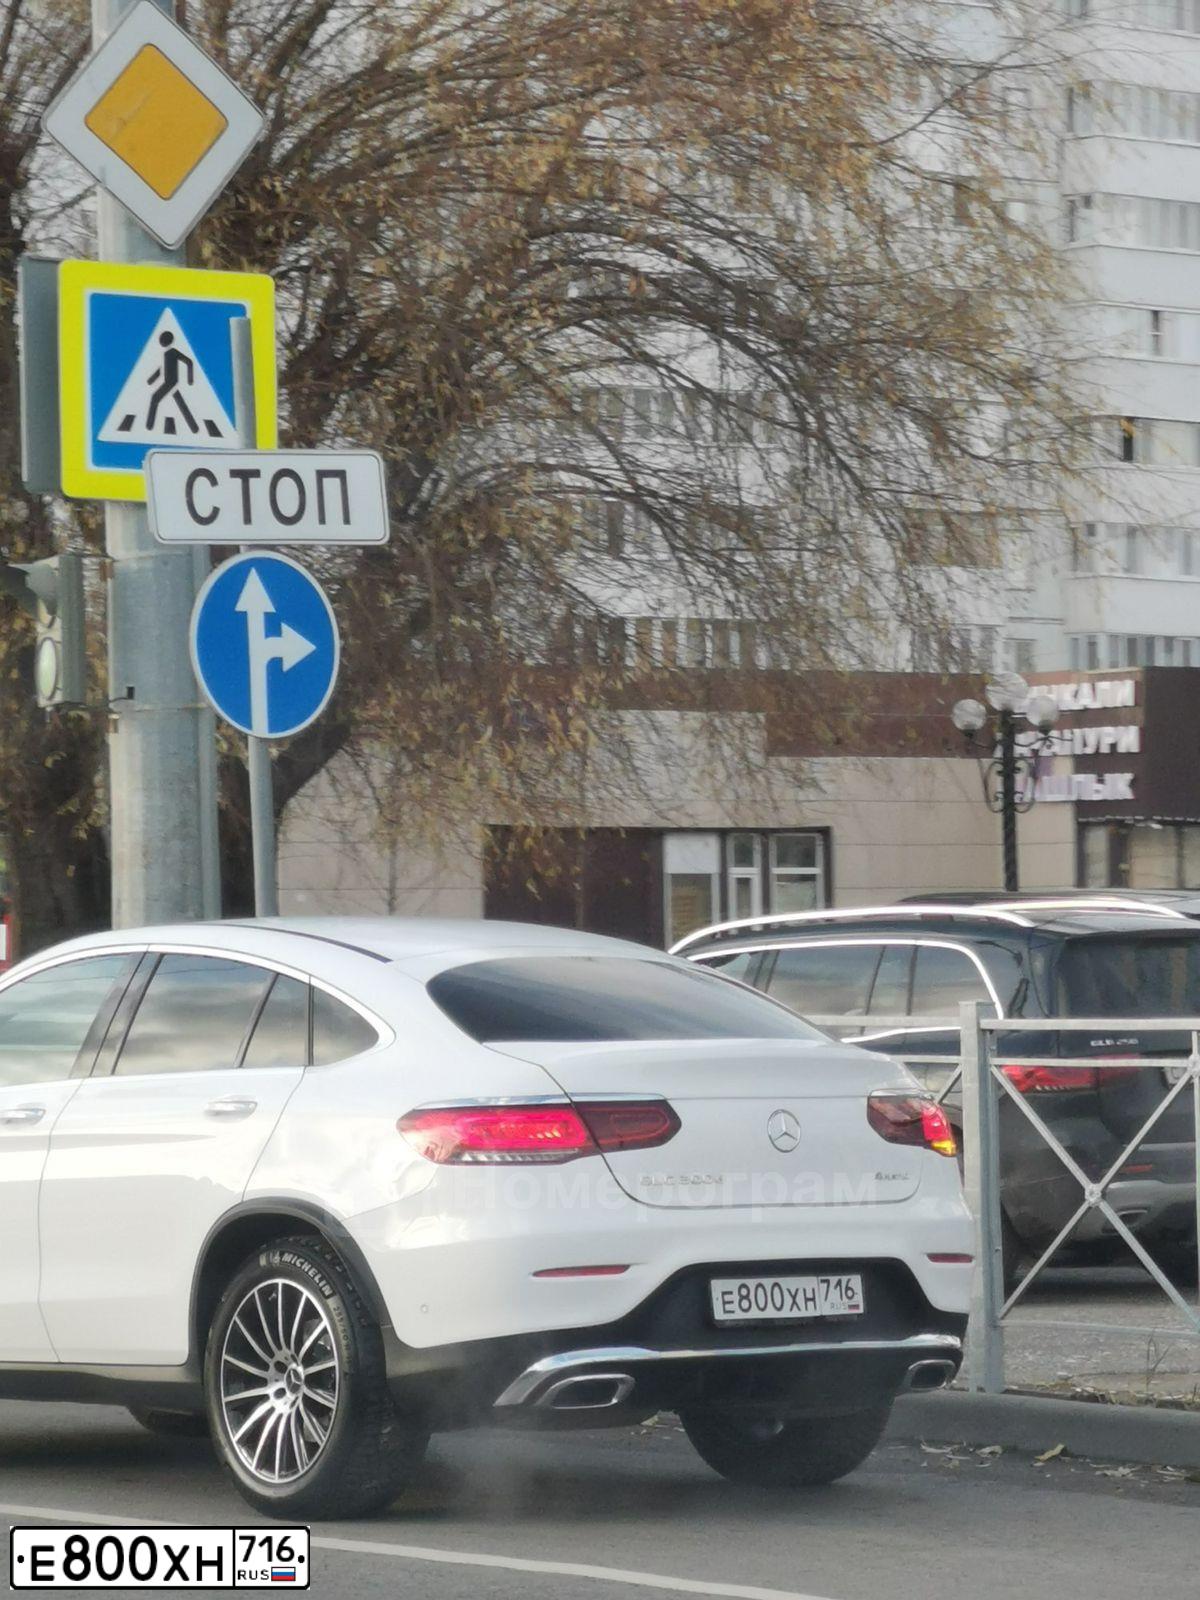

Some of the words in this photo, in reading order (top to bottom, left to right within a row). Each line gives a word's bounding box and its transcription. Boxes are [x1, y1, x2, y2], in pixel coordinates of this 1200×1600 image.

[185, 467, 351, 526] СТОП
[281, 1252, 334, 1298] MICHELIN
[720, 1281, 818, 1315] Е800ХН
[820, 1277, 856, 1302] 716
[830, 1303, 847, 1311] RUS
